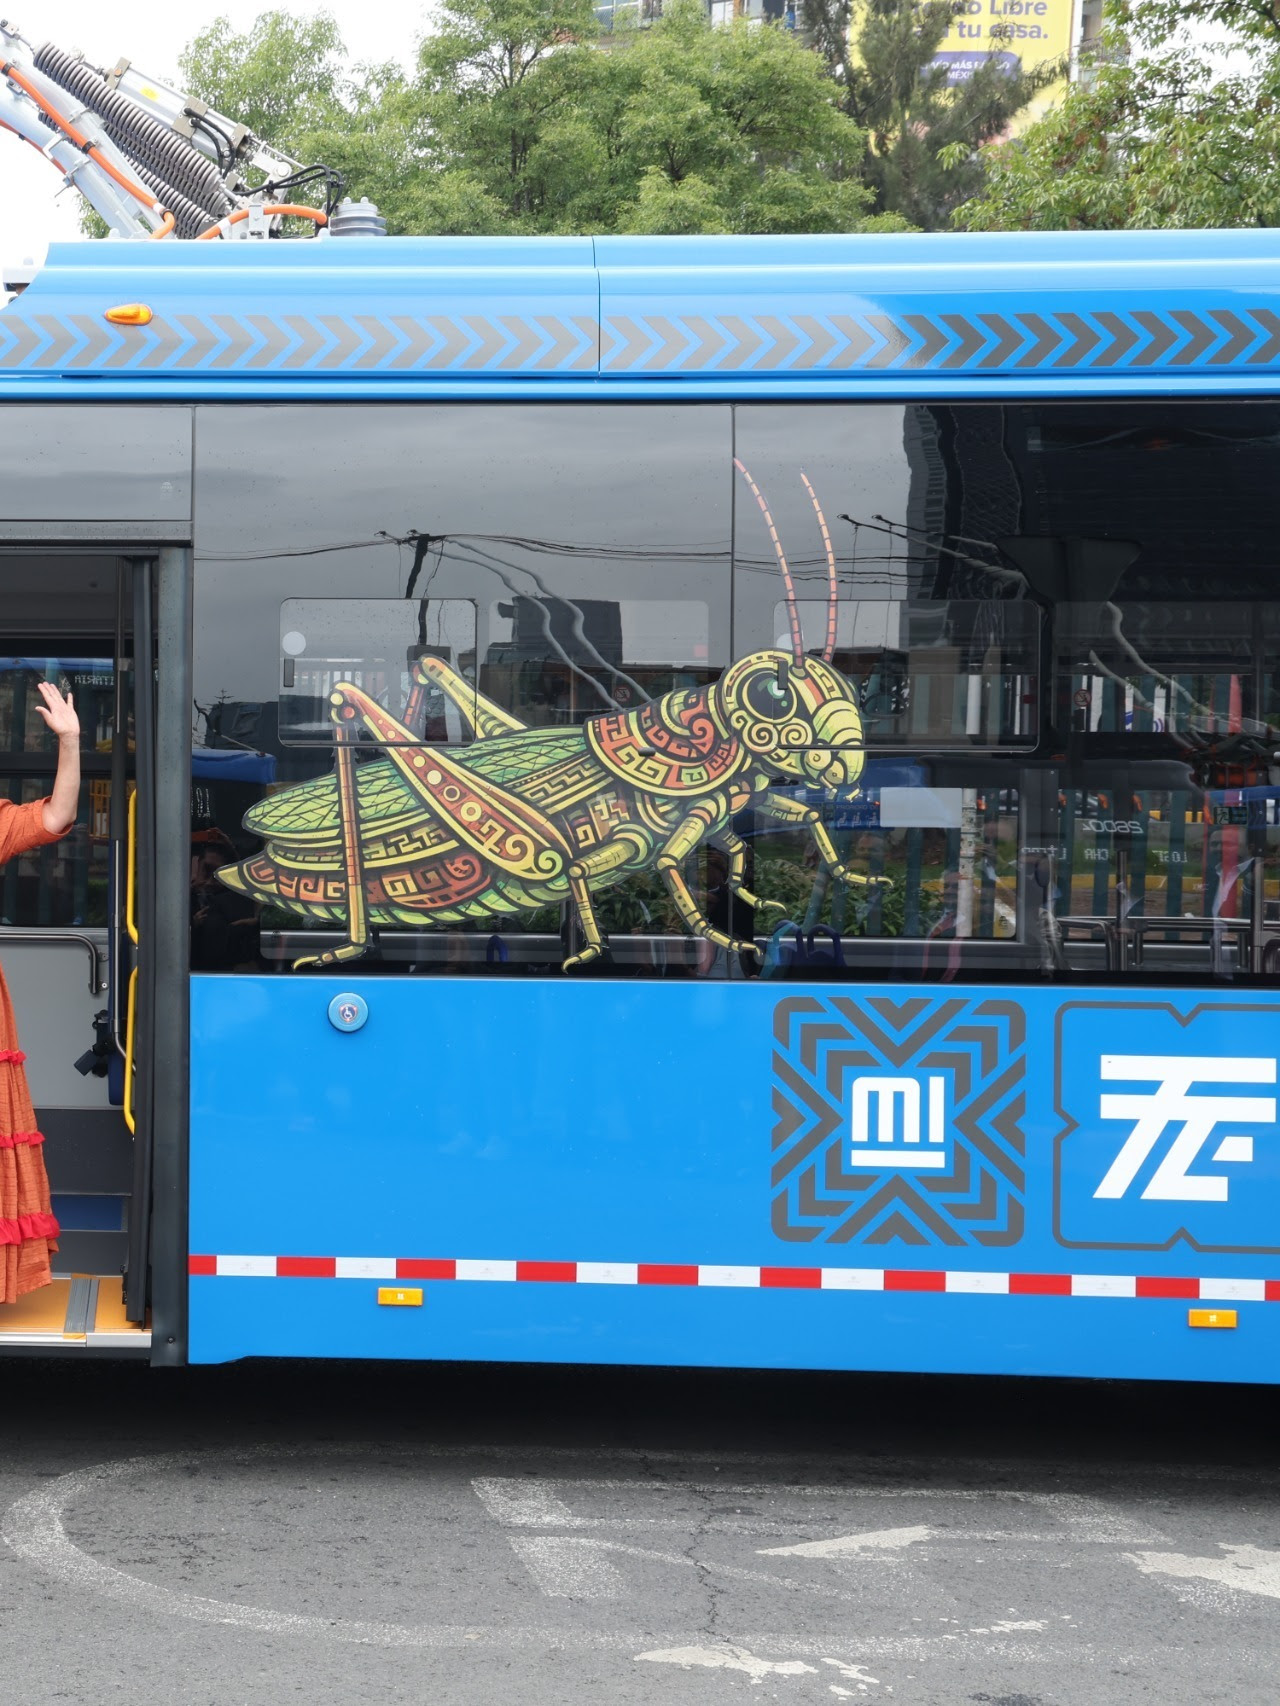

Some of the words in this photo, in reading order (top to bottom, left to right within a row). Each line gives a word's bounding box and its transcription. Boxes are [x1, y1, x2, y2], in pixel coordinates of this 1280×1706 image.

[990, 0, 1048, 15] Libre
[957, 21, 981, 38] tu
[989, 24, 1048, 39] casa.
[951, 60, 973, 69] MÁS
